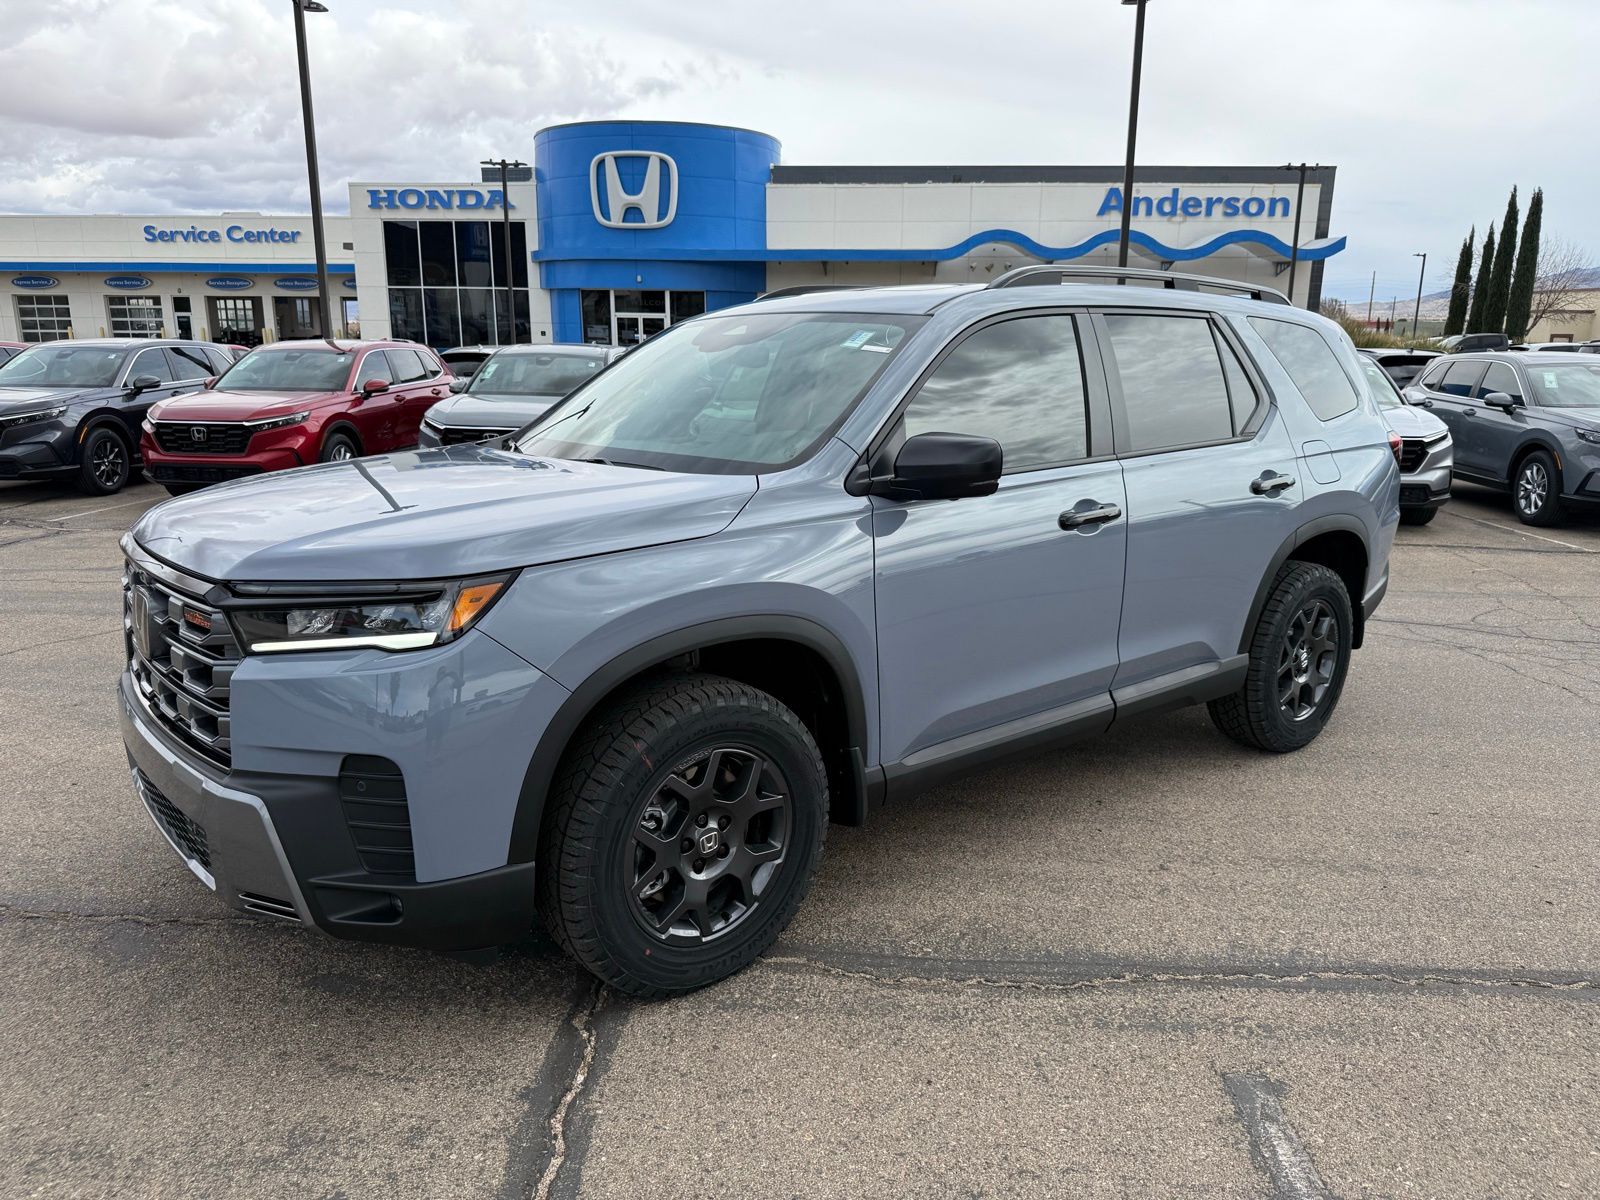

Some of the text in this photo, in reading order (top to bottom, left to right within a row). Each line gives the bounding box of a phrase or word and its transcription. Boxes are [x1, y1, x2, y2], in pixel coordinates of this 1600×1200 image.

[366, 188, 516, 210] HONDA
[1096, 187, 1291, 217] Anderson
[143, 225, 301, 243] Service Center
